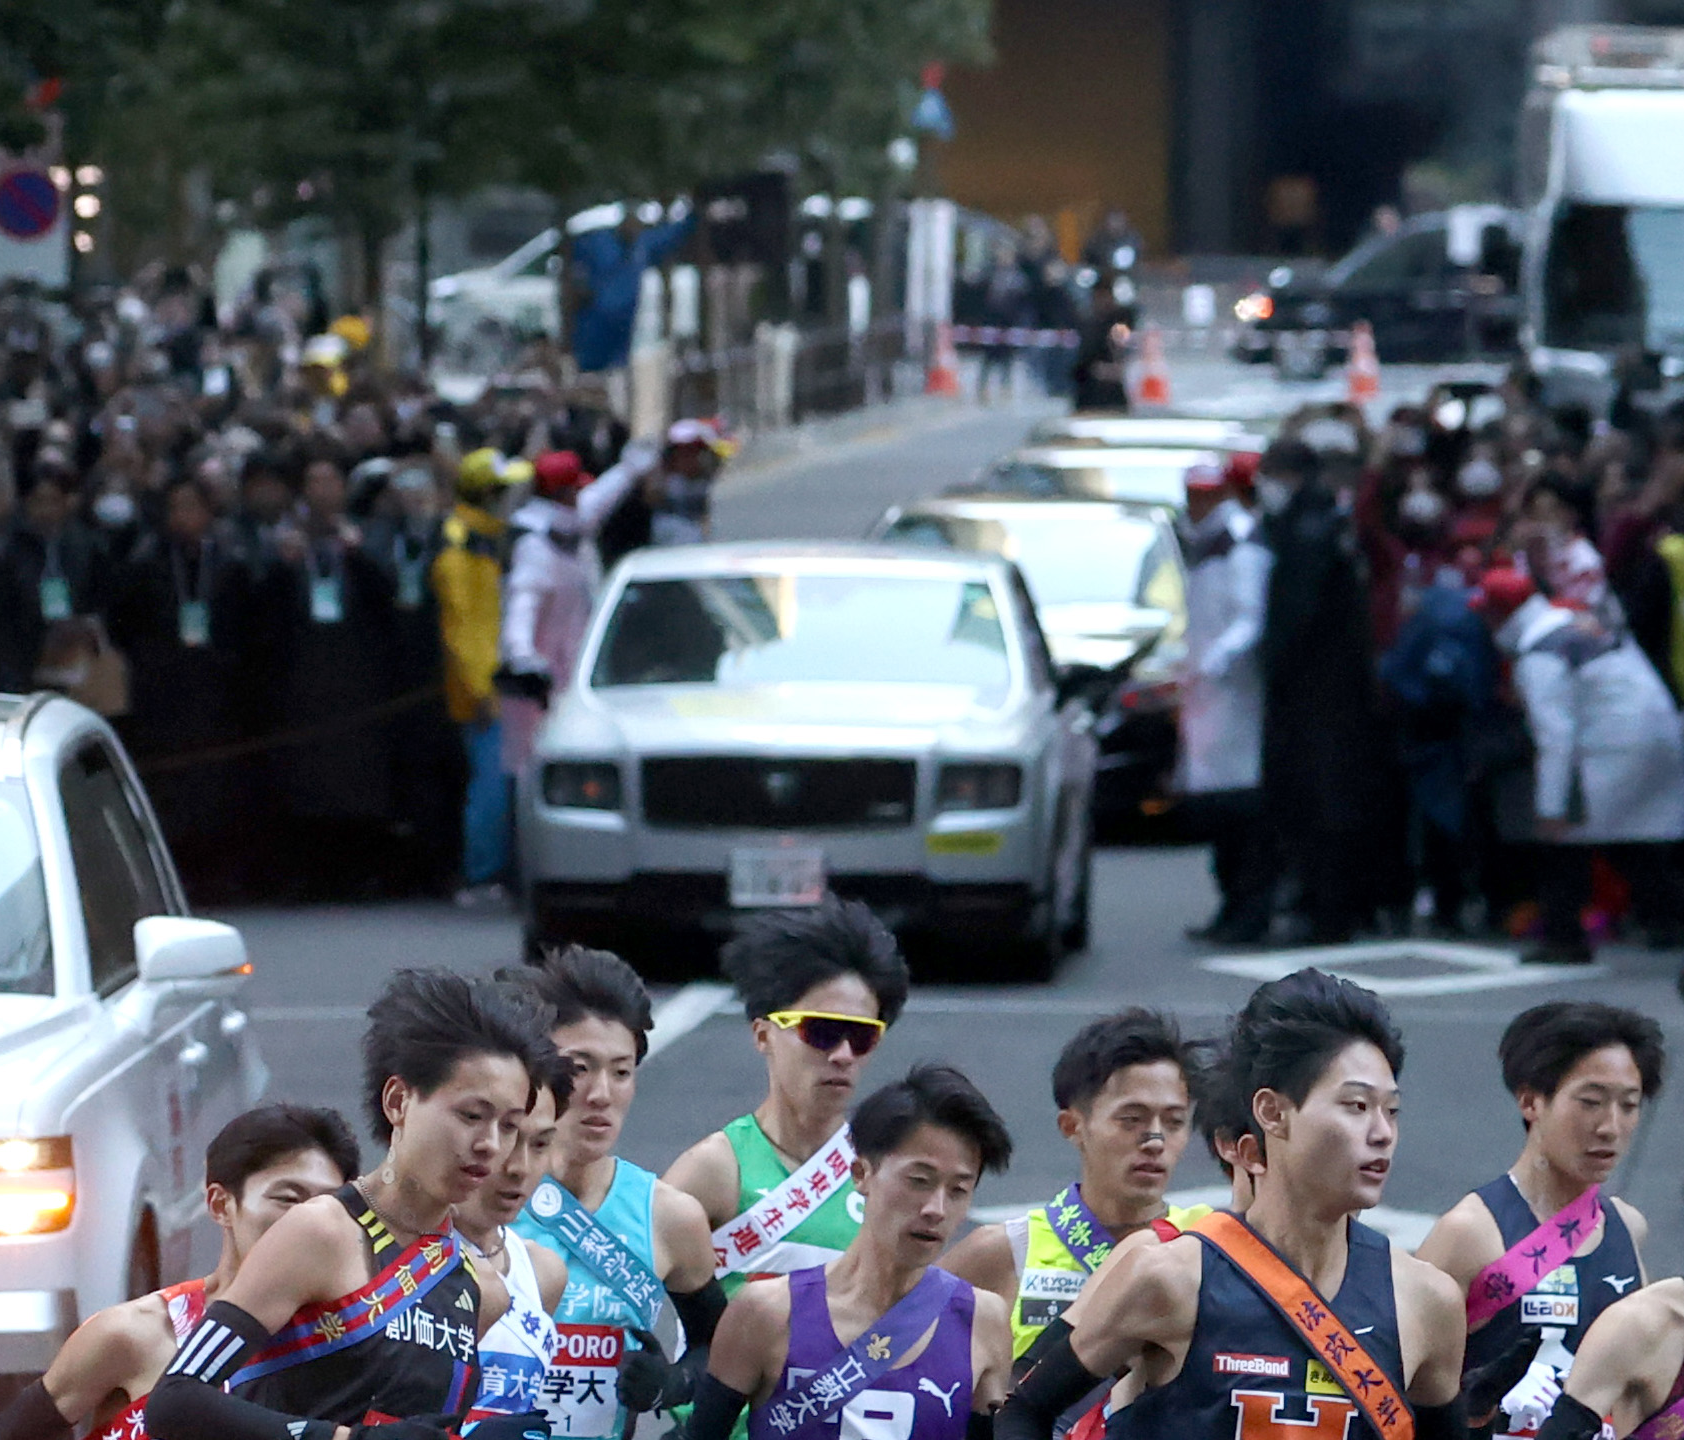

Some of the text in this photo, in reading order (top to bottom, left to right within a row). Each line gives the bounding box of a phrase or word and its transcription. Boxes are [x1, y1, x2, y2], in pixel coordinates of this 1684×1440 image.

[315, 1240, 449, 1344] 創価大学
[385, 1300, 475, 1363] 創価大学
[768, 1355, 866, 1436] 立教大学
[1216, 1355, 1289, 1376] ThreeBond
[1296, 1300, 1402, 1427] 法政大学
